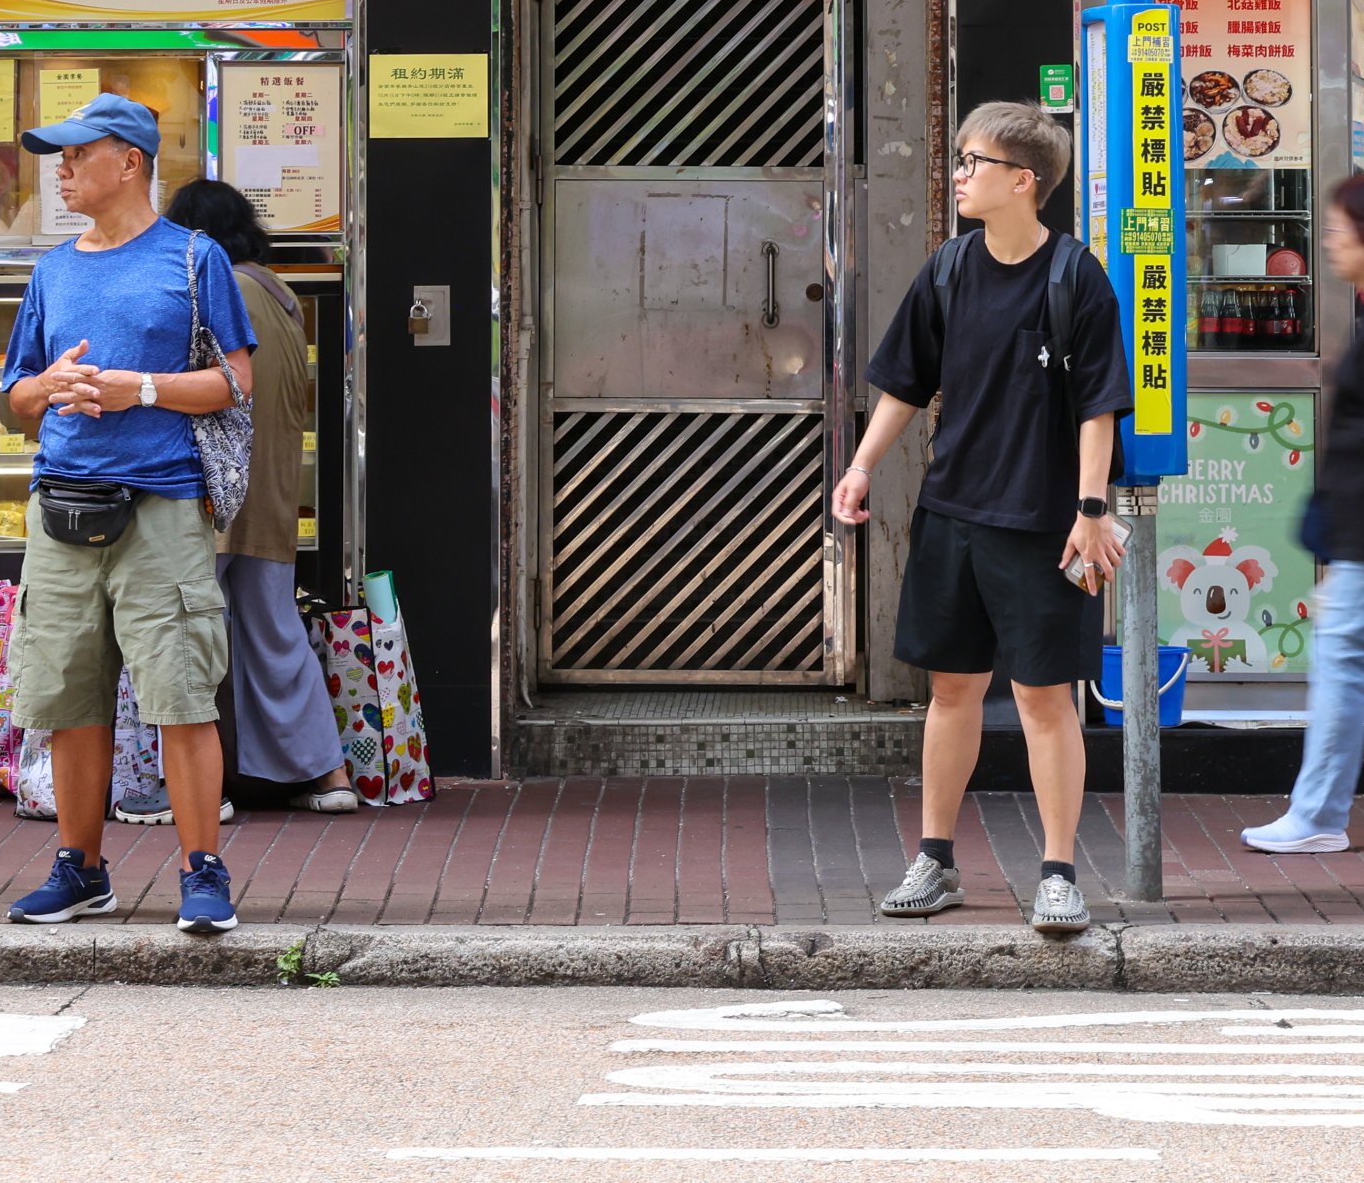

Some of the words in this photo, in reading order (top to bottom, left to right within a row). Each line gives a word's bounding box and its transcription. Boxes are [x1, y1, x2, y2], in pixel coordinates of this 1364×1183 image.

[1138, 22, 1166, 32] POST
[1227, 44, 1295, 58] 梅菜肉餅飯
[391, 67, 465, 80] 租約期滿
[260, 77, 305, 86] 精選飯餐
[294, 126, 316, 135] OFF
[1140, 72, 1166, 197] 嚴禁標貼
[1124, 216, 1170, 231] 上門補習
[1141, 264, 1167, 390] 嚴禁標貼
[1158, 483, 1274, 505] CHRISTMAS
[1198, 507, 1232, 523] 金園
